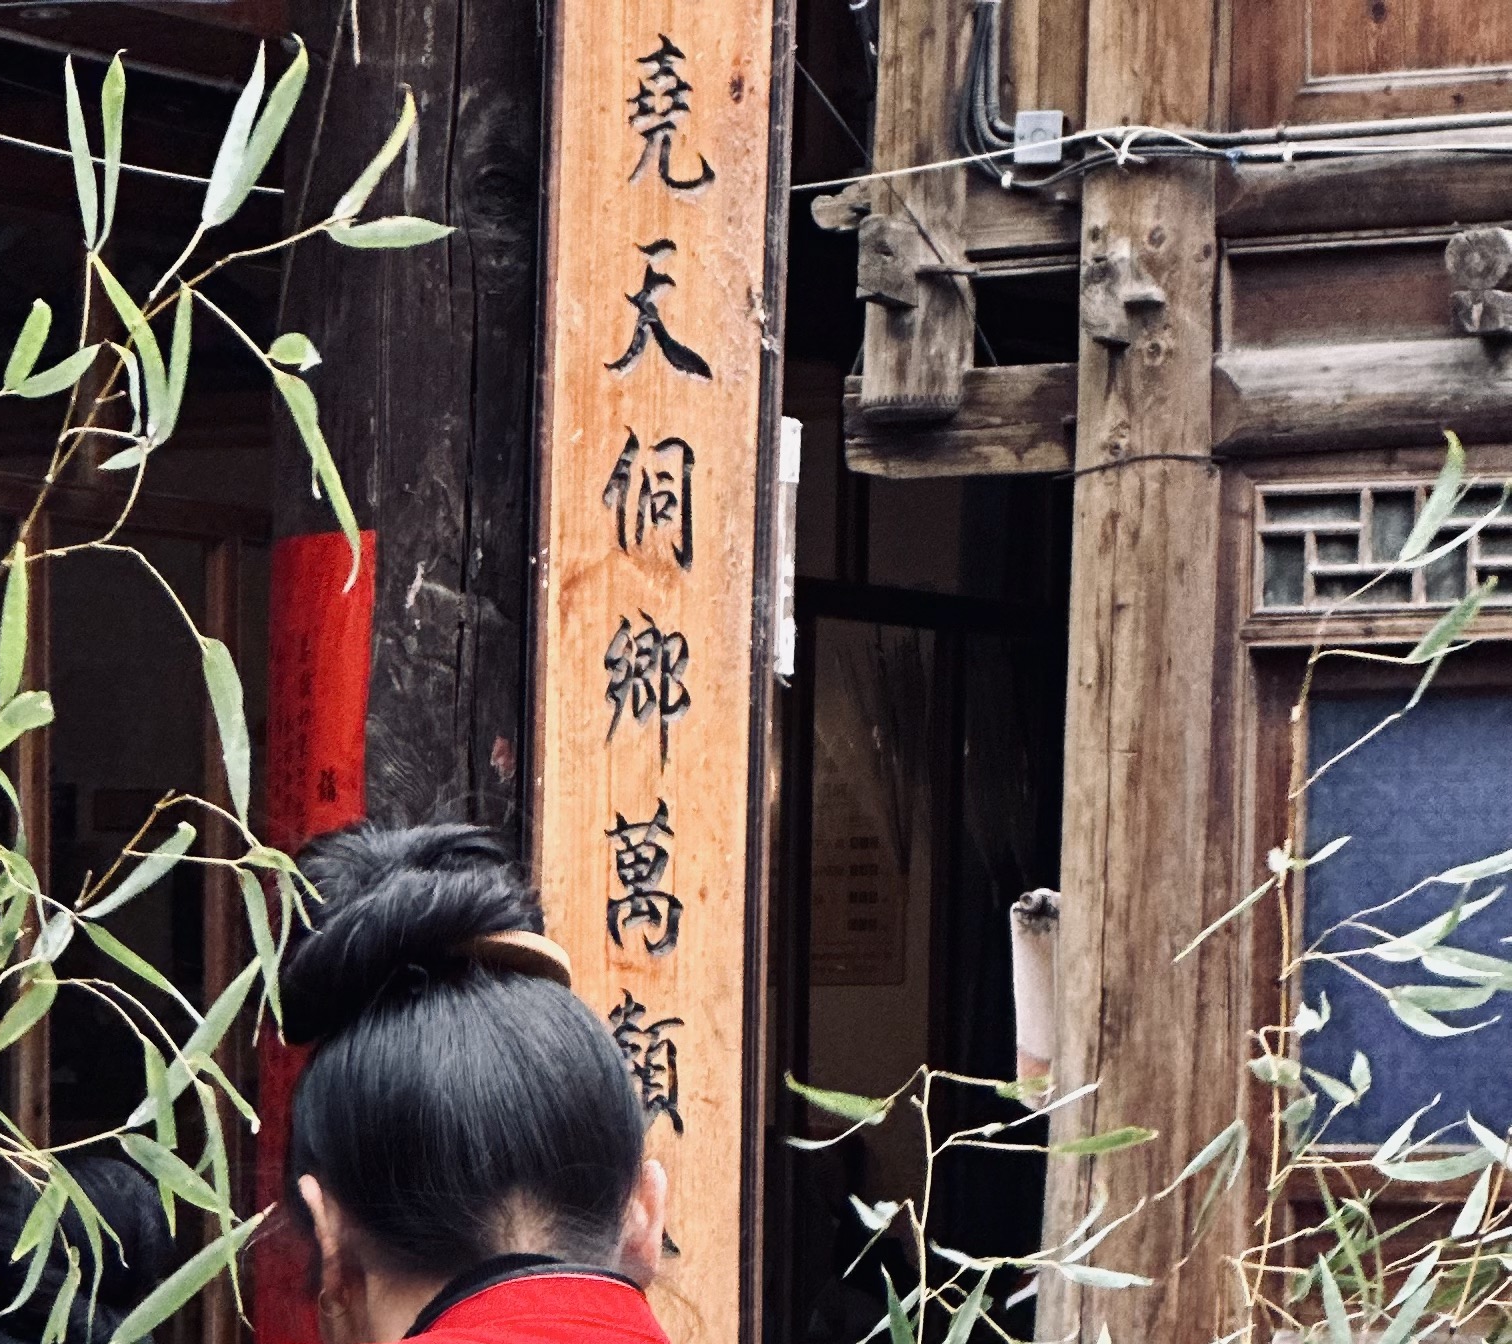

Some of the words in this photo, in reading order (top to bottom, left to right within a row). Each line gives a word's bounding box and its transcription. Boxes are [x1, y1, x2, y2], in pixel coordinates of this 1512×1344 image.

[604, 34, 714, 1257] 堯天侗鄉萬類
